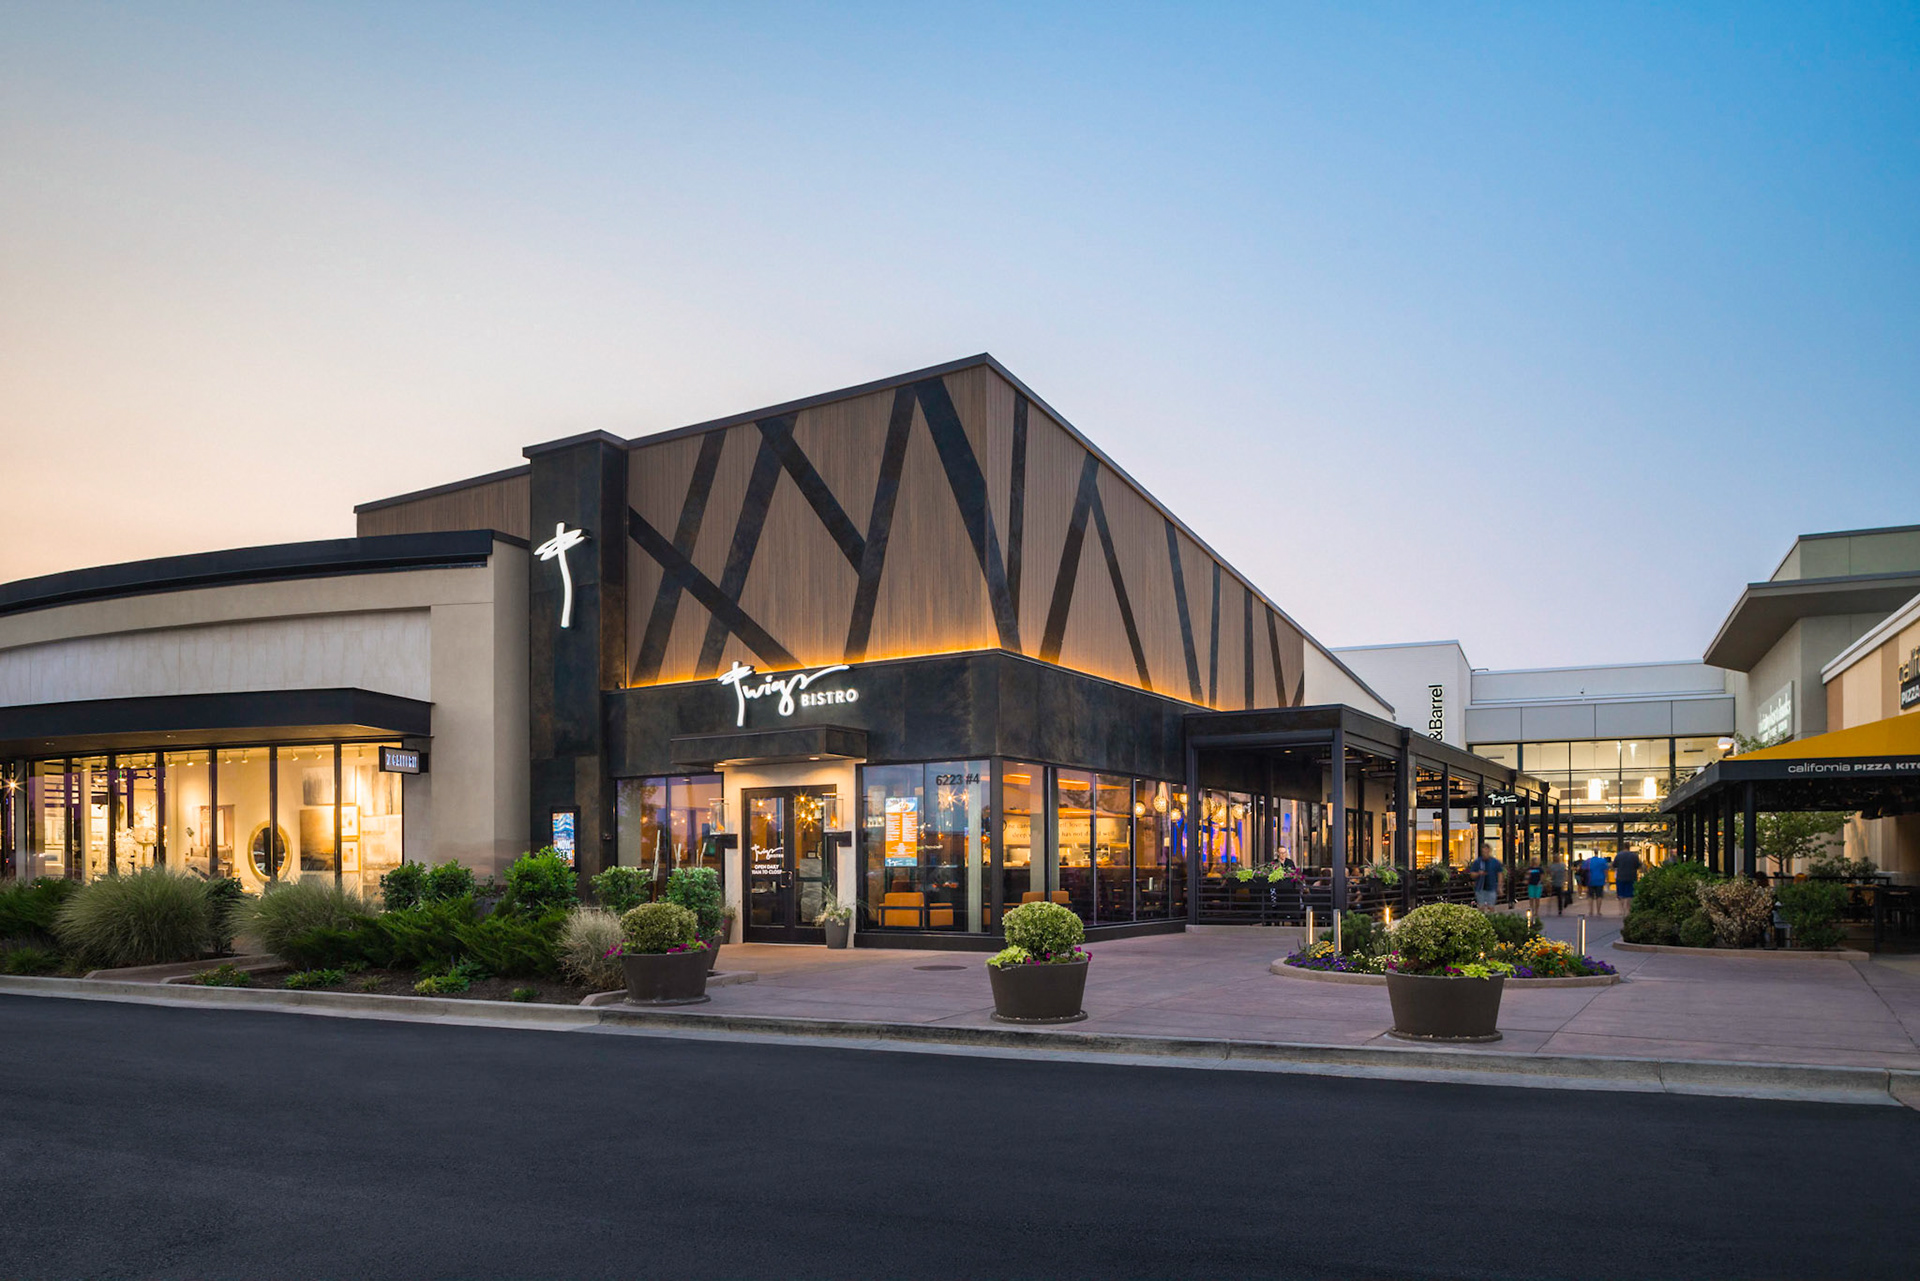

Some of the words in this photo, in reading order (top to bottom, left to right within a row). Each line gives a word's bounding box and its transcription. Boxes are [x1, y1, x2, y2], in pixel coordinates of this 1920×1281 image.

[717, 661, 850, 727] Twigs
[801, 689, 859, 707] BISTRO
[1788, 763, 1851, 773] california
[1854, 763, 1892, 771] PIZZA
[936, 774, 963, 786] 6223
[966, 773, 980, 785] #4
